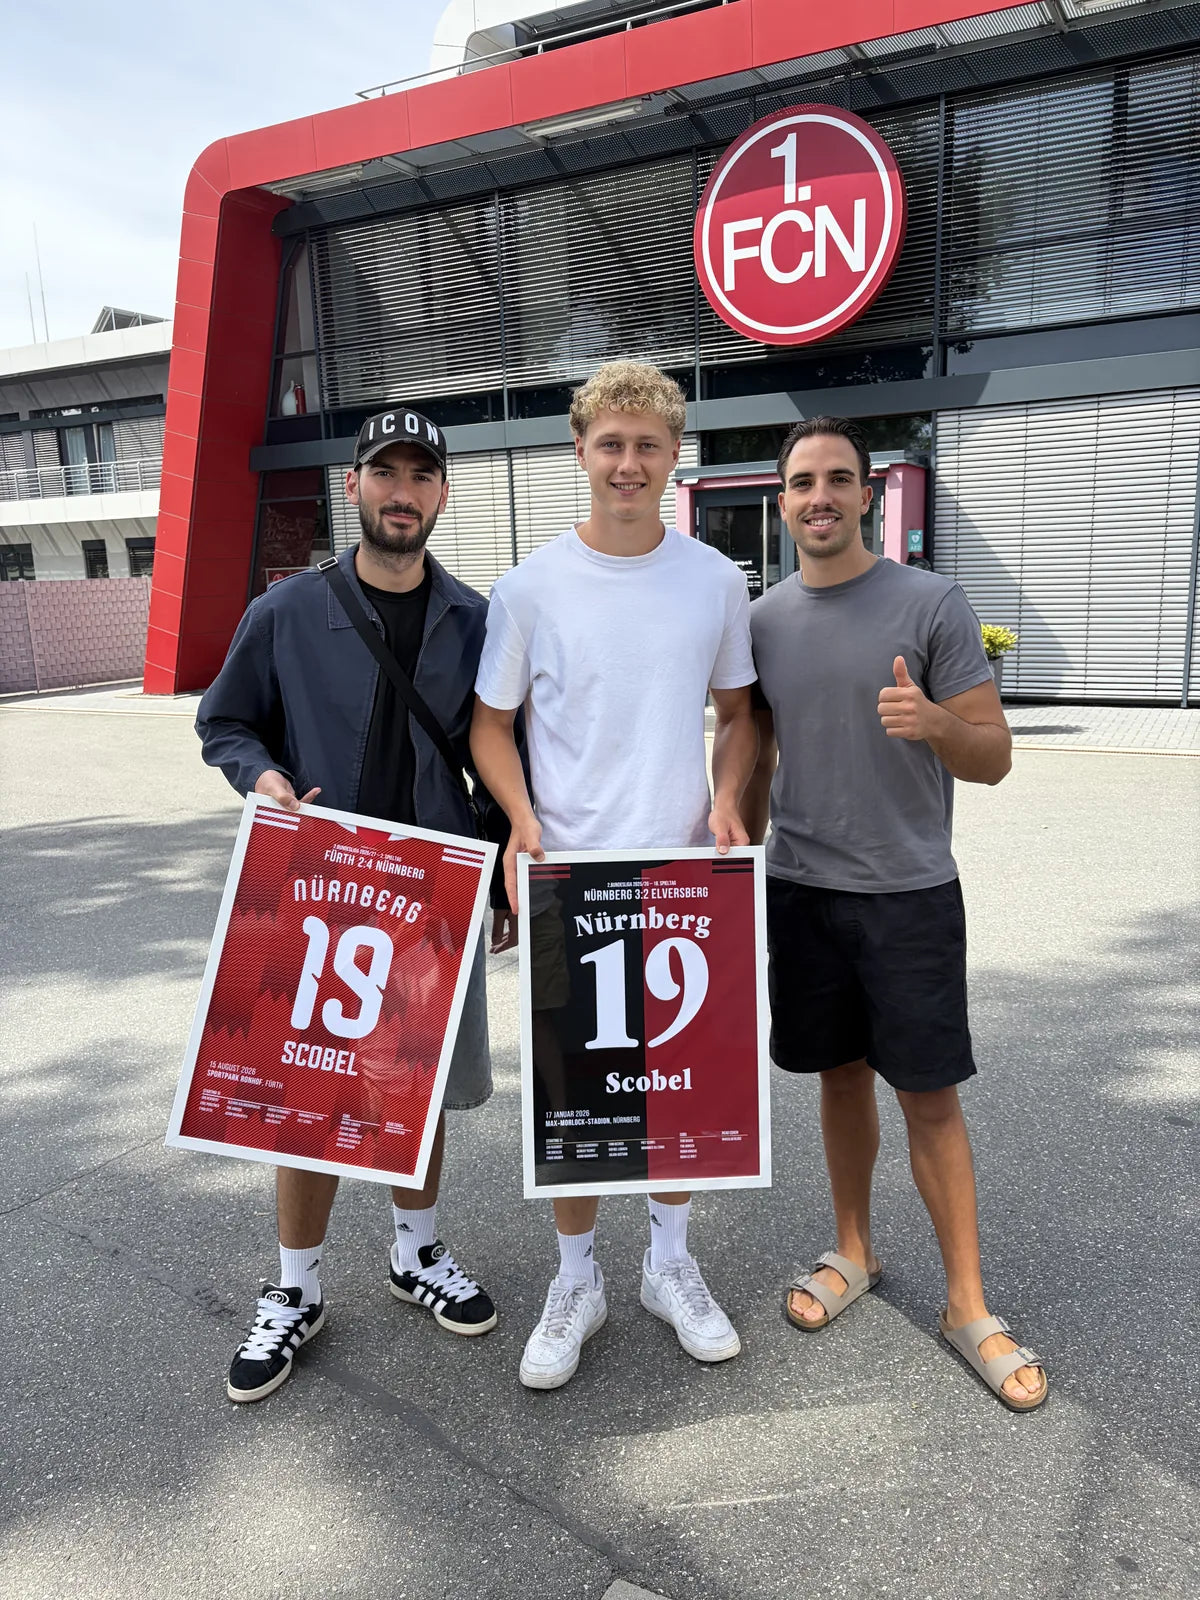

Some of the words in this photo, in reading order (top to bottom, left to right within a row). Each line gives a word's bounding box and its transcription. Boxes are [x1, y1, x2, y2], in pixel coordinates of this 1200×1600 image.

[771, 132, 811, 204] 1.
[722, 198, 866, 292] FCN
[369, 413, 439, 446] ICON
[324, 849, 355, 866] FÜRTH
[357, 857, 372, 869] 2:4
[375, 860, 425, 880] NÜRNBERG
[294, 875, 422, 923] NÜRNBERG
[584, 888, 632, 901] NÜRNBERG
[634, 888, 649, 900] 3:2
[651, 887, 709, 899] ELVERSBERG
[574, 906, 712, 939] Nürnberg
[290, 915, 394, 1040] 19
[580, 937, 709, 1050] 19
[209, 1060, 217, 1069] 15
[217, 1062, 240, 1072] AUGUST
[240, 1066, 257, 1075] 2026
[281, 1040, 358, 1076] SCOBEL
[207, 1069, 239, 1082] SPORTPARK
[264, 1079, 284, 1089] FÜRTH
[605, 1067, 692, 1093] Scobel
[545, 1111, 552, 1119] 17
[553, 1110, 575, 1118] JANUAR
[575, 1109, 590, 1117] 2026
[545, 1117, 612, 1127] MAX-MORLOCK-STADION,
[612, 1115, 641, 1124] NÜRNBERG
